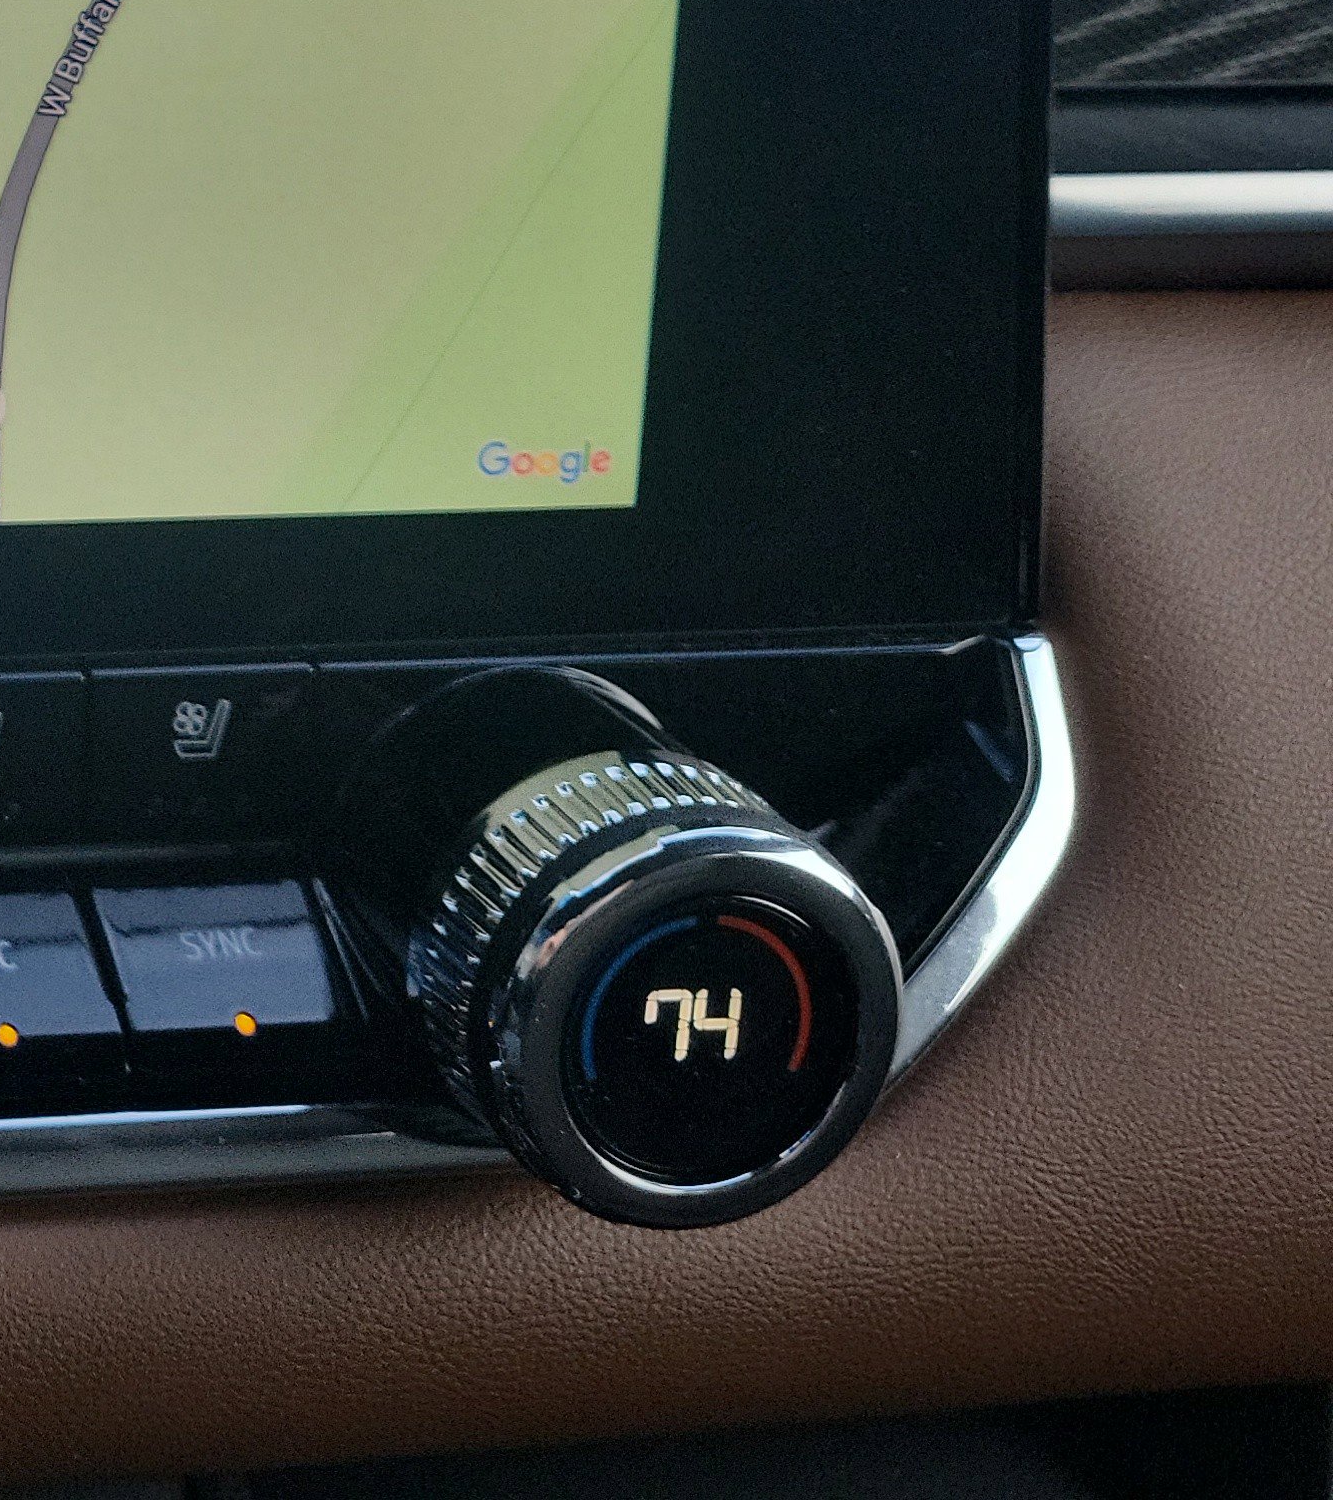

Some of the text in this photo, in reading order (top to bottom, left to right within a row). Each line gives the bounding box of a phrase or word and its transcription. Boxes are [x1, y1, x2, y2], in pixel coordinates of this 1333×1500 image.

[38, 83, 71, 116] W
[477, 440, 611, 484] Google
[180, 928, 261, 960] SYNC
[644, 988, 742, 1061] 74
